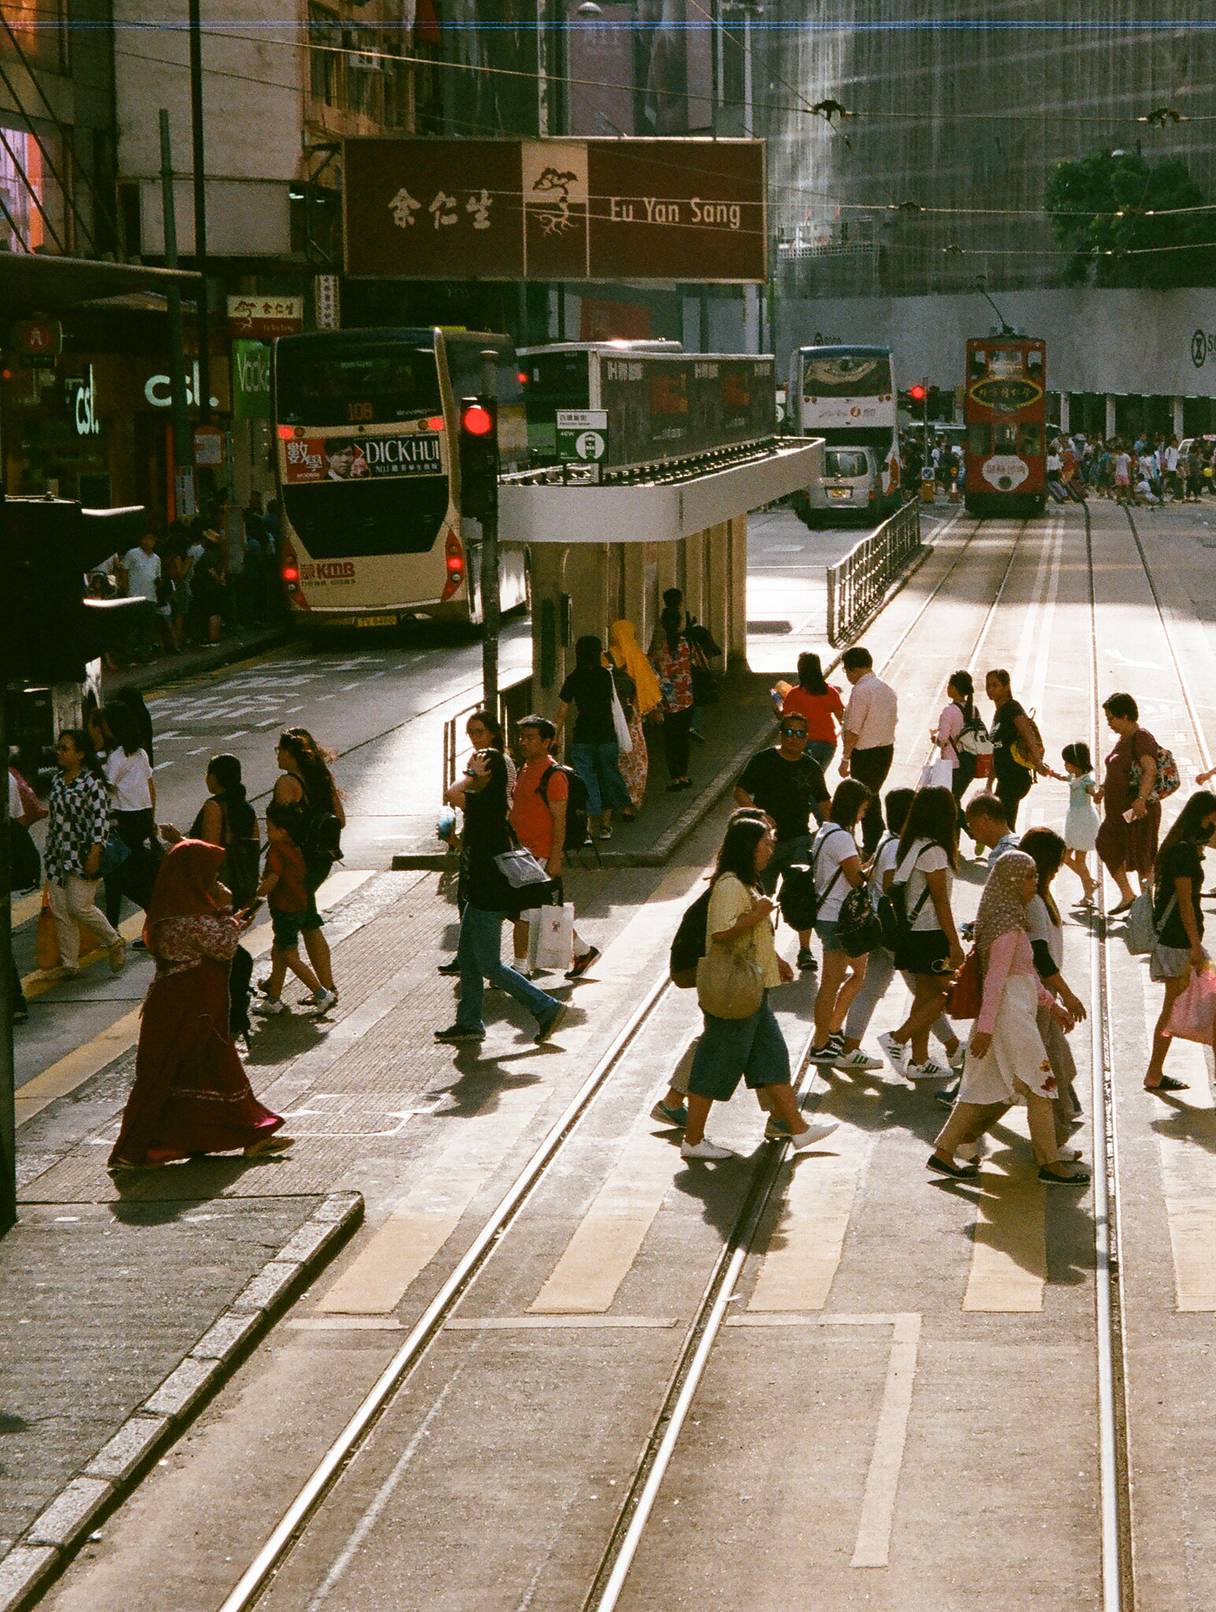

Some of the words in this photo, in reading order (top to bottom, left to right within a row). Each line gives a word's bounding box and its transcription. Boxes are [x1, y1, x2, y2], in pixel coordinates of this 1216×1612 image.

[388, 188, 493, 230] 余仁生
[611, 197, 633, 223] Eu
[643, 197, 680, 223] Yan
[691, 197, 741, 229] Sang
[76, 362, 100, 436] csl.
[144, 359, 220, 408] cl.
